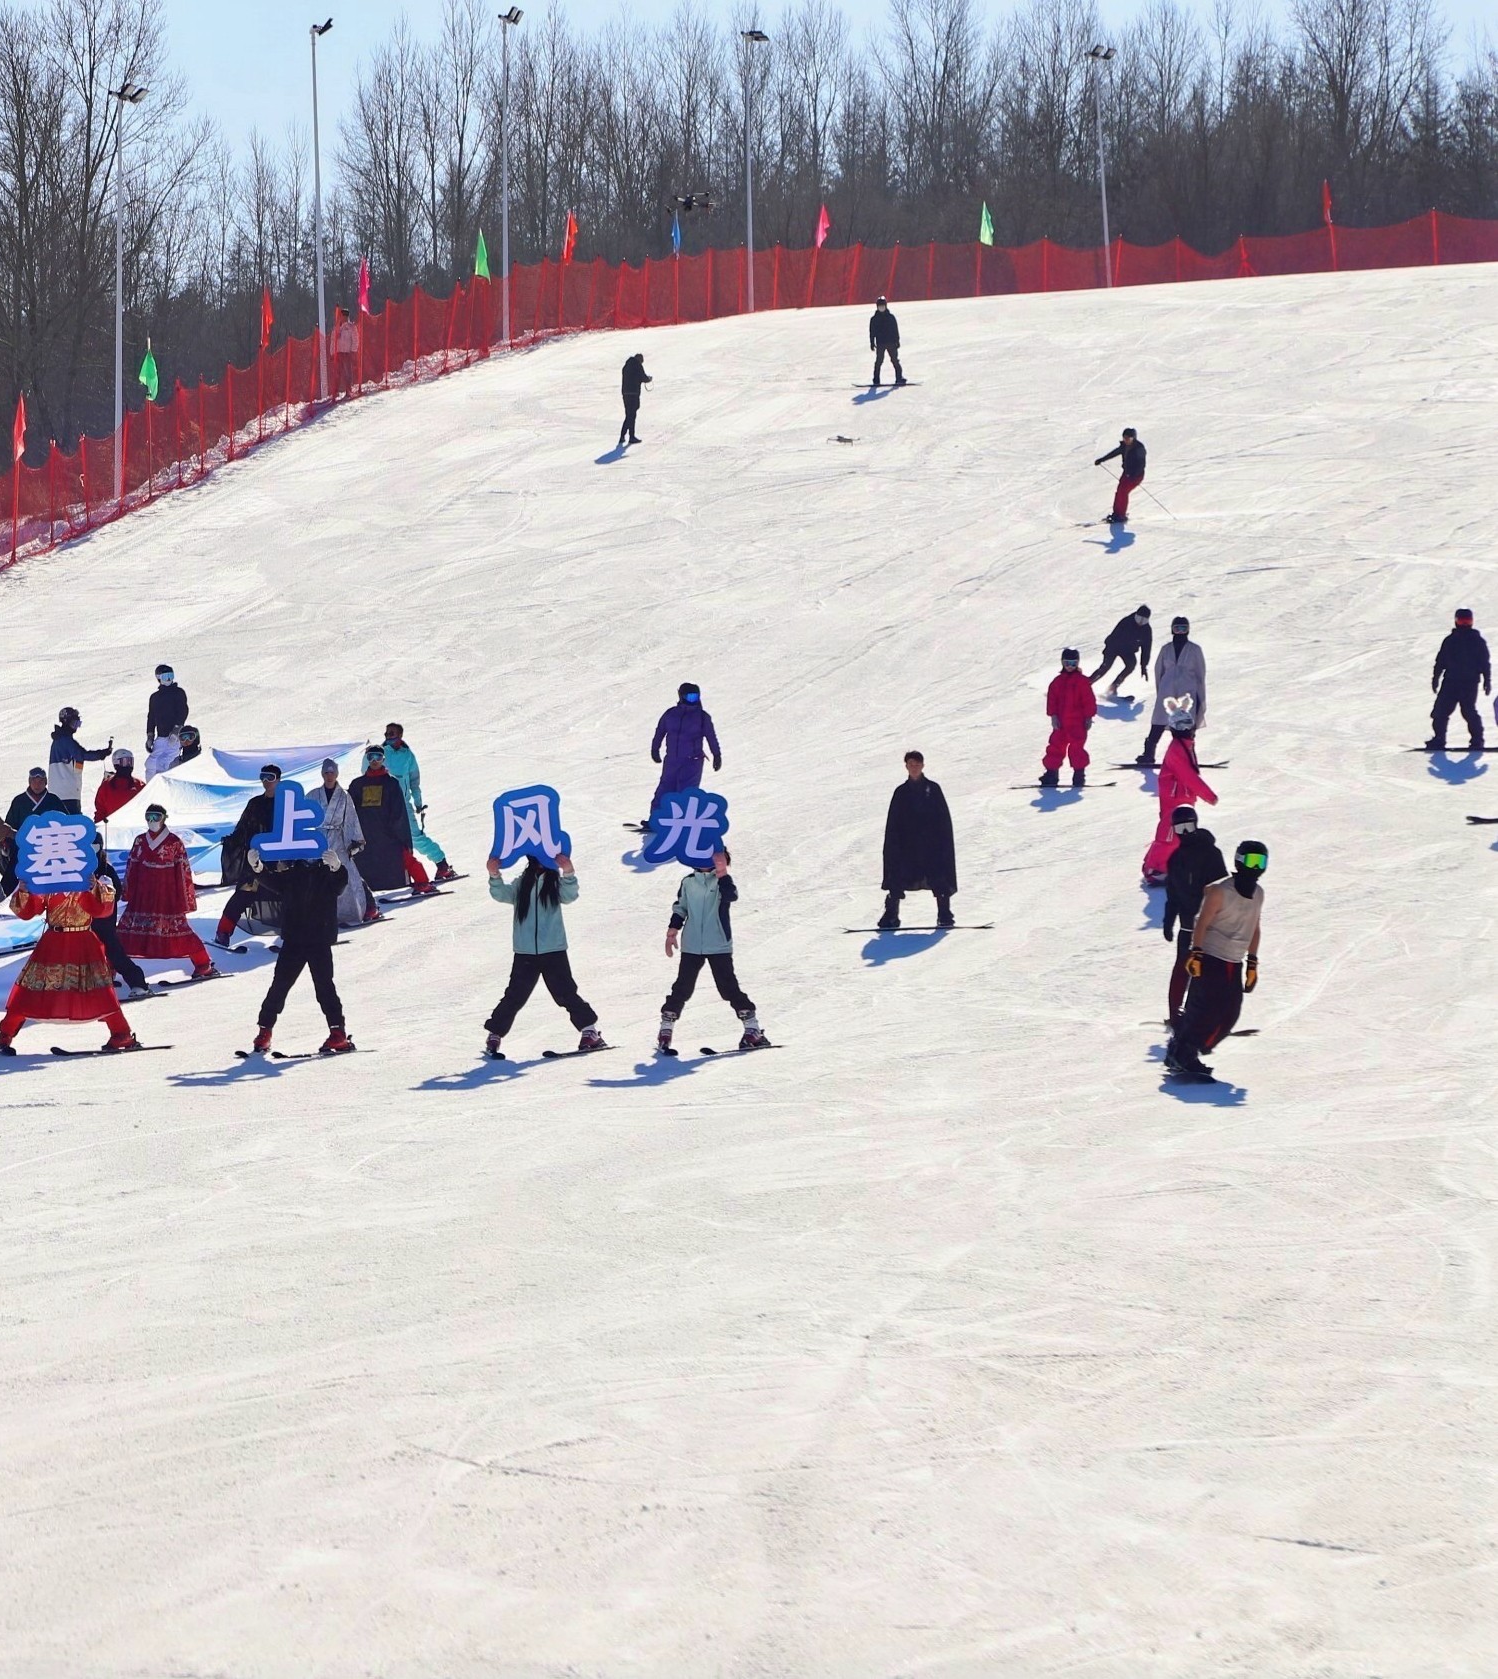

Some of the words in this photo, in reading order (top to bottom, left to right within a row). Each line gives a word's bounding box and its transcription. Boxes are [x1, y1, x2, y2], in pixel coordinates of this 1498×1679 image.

[261, 789, 318, 851] 上
[500, 795, 562, 859] 风
[654, 797, 719, 859] 光
[25, 820, 86, 885] 塞
